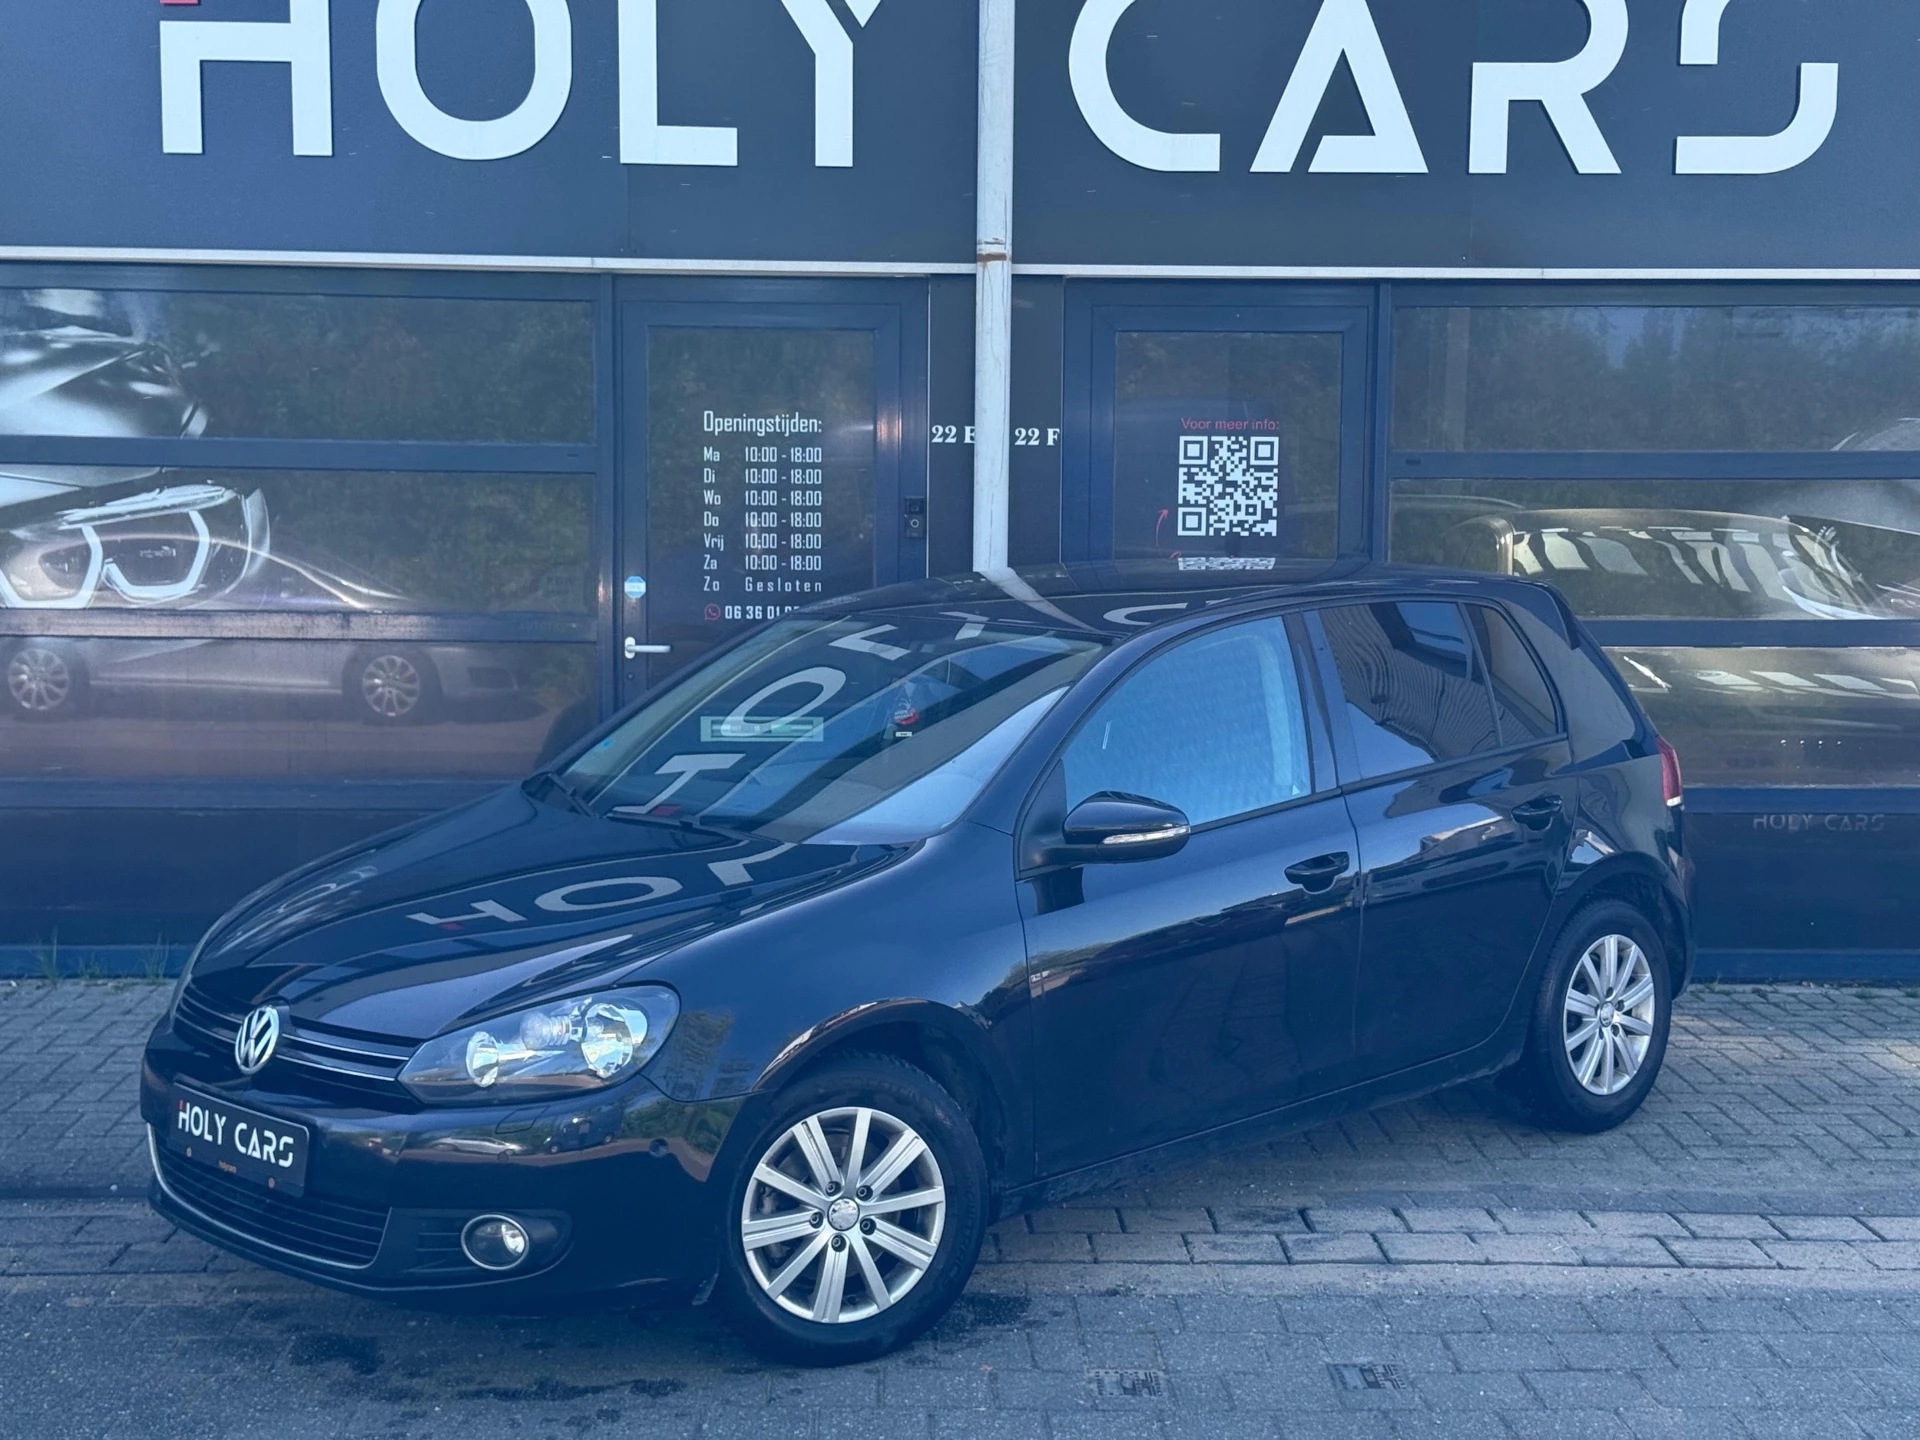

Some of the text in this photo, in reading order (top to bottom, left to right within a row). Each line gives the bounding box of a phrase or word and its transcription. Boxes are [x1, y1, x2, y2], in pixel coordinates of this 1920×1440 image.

[703, 409, 823, 437] Openingstijden:
[1181, 417, 1280, 431] Voor meer info:
[931, 424, 958, 444] 22
[1013, 427, 1060, 446] 22 F
[703, 446, 721, 462] Ma
[744, 446, 778, 463] 10:00
[790, 446, 823, 463] 18:00
[703, 467, 716, 484] Di
[744, 468, 778, 485] 10:00
[790, 468, 823, 485] 18:00
[703, 489, 722, 506] Wo
[744, 490, 778, 507] 10:00
[790, 490, 823, 507] 18:00
[703, 511, 720, 527] Do
[744, 511, 778, 528] 10:00
[790, 511, 823, 528] 18:00
[703, 533, 725, 551] Vrij
[744, 533, 778, 550] 10:00
[790, 533, 823, 550] 18:00
[703, 554, 718, 570] Za
[744, 555, 778, 572] 10:00
[790, 555, 823, 572] 18:00
[703, 576, 822, 593] Zo Gesloten
[724, 604, 742, 620] 06
[745, 605, 763, 620] 36
[766, 605, 781, 620] 01
[1752, 813, 1885, 832] HOLY CARS
[177, 1099, 295, 1168] HOLY CARS
